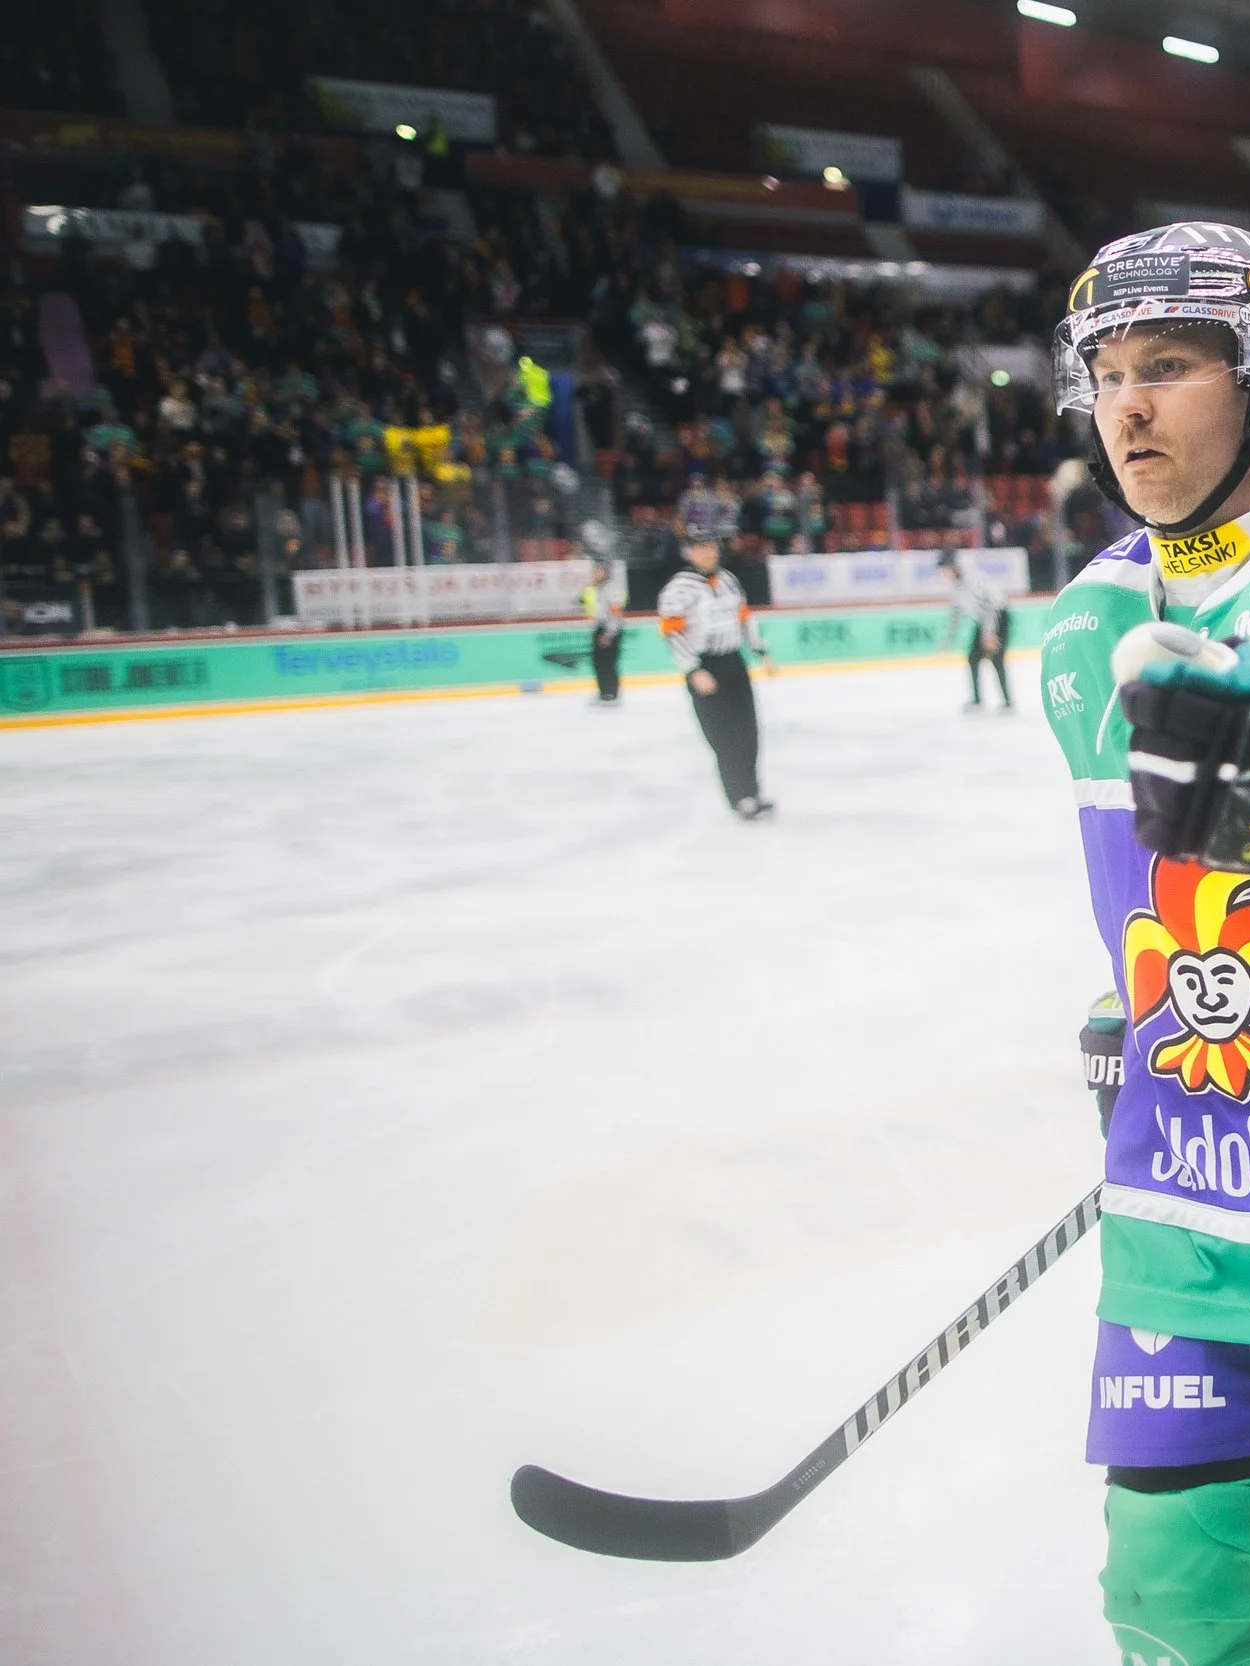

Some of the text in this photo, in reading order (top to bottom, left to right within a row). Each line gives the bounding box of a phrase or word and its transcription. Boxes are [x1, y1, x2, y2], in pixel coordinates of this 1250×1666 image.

[1106, 256, 1180, 274] CREATIVE
[1107, 267, 1180, 281] TECHNOLOGY
[1128, 286, 1142, 294] Live
[1143, 284, 1169, 293] Events
[1101, 307, 1152, 324] GLASSDRVE
[1181, 305, 1236, 319] GLASSDRIVE
[1160, 530, 1221, 559] TAKSI
[1047, 671, 1084, 708] RTK
[1100, 1375, 1227, 1410] INFUEL
